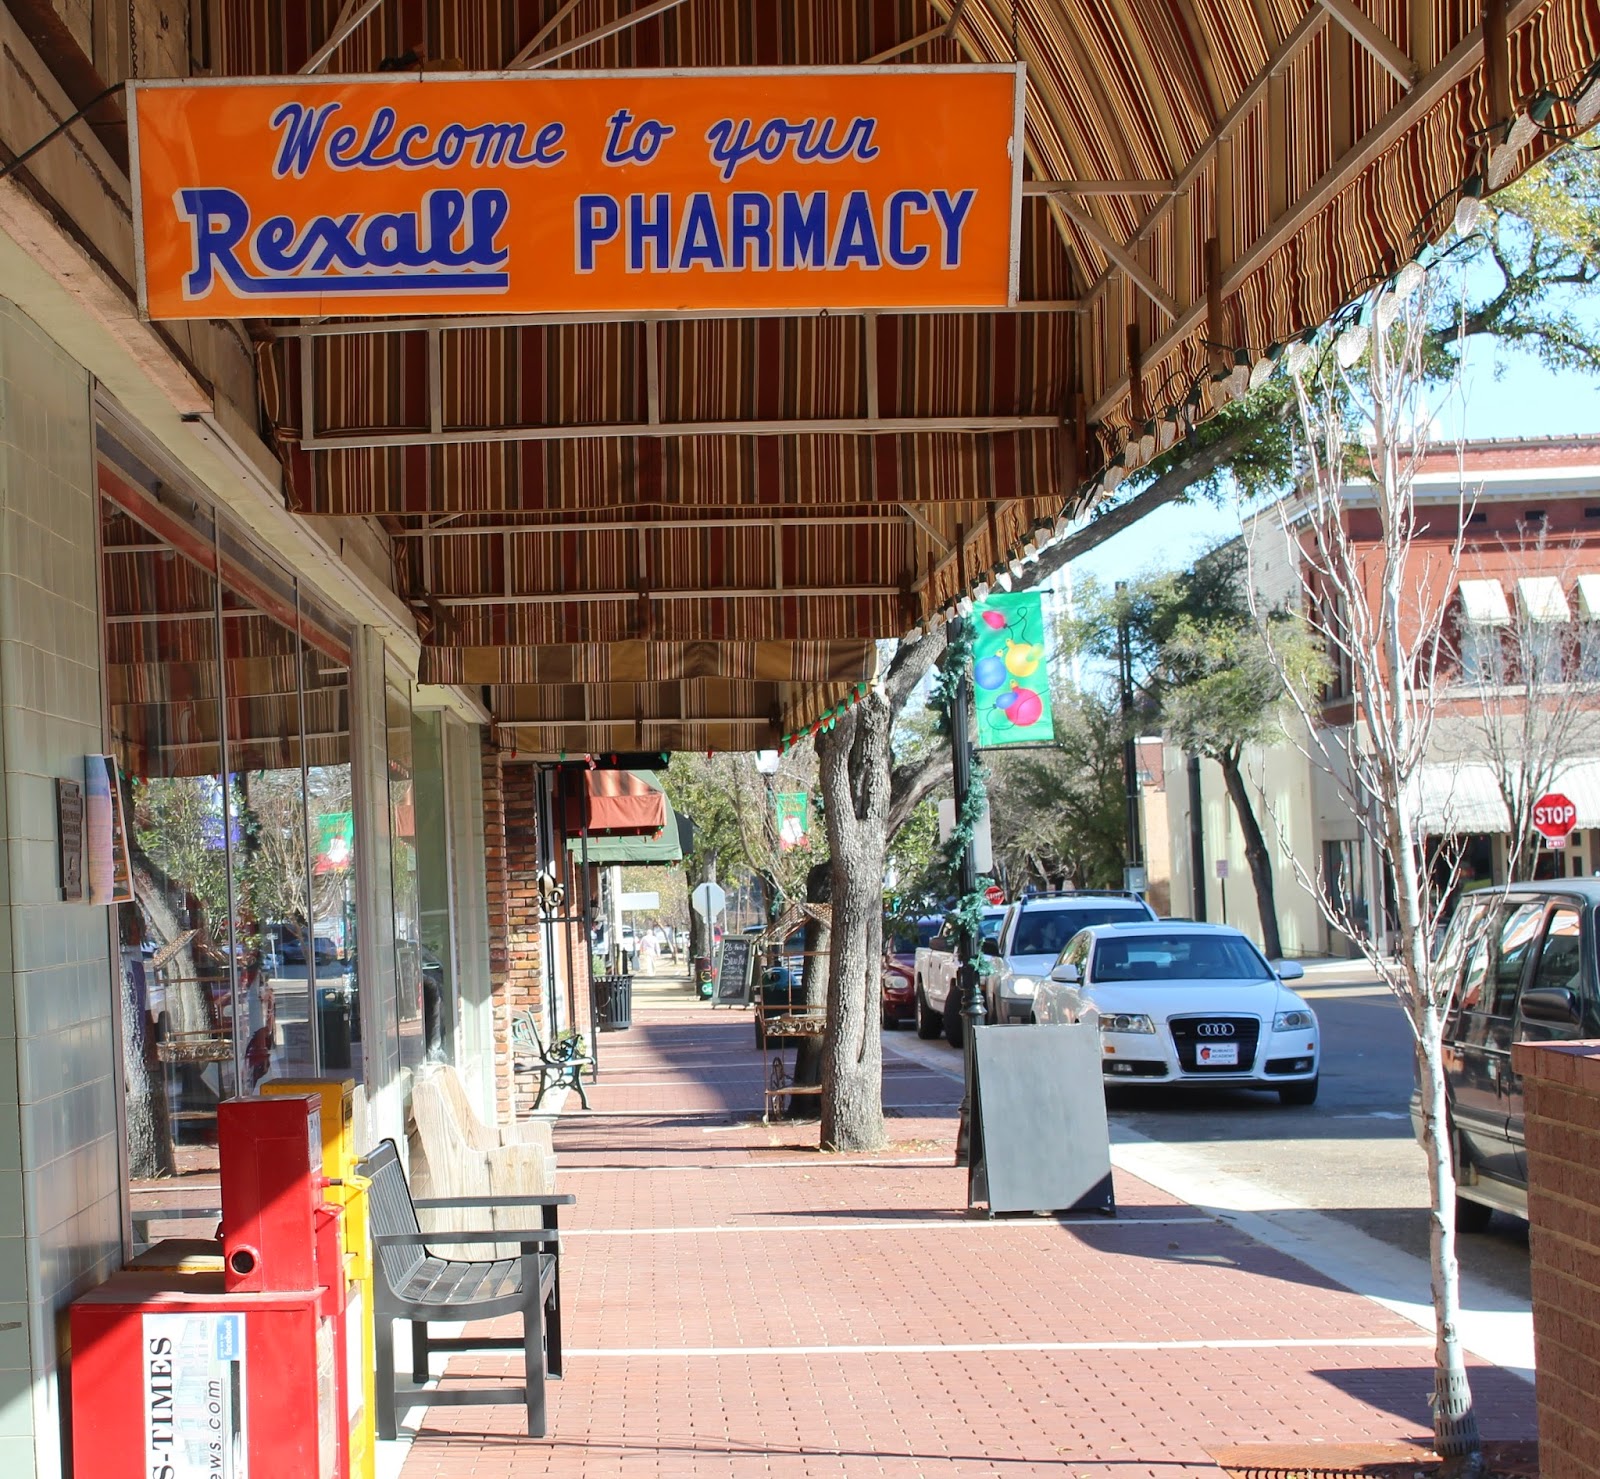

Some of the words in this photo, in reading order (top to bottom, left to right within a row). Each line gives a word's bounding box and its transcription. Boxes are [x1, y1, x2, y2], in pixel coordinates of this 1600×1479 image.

[269, 101, 567, 179] Welcome
[602, 108, 675, 167] to
[705, 116, 880, 183] your
[173, 187, 510, 300] Rexall
[574, 188, 978, 274] PHARMACY
[1535, 806, 1574, 825] STOP
[986, 891, 1003, 899] STOP
[224, 1319, 233, 1355] facebook
